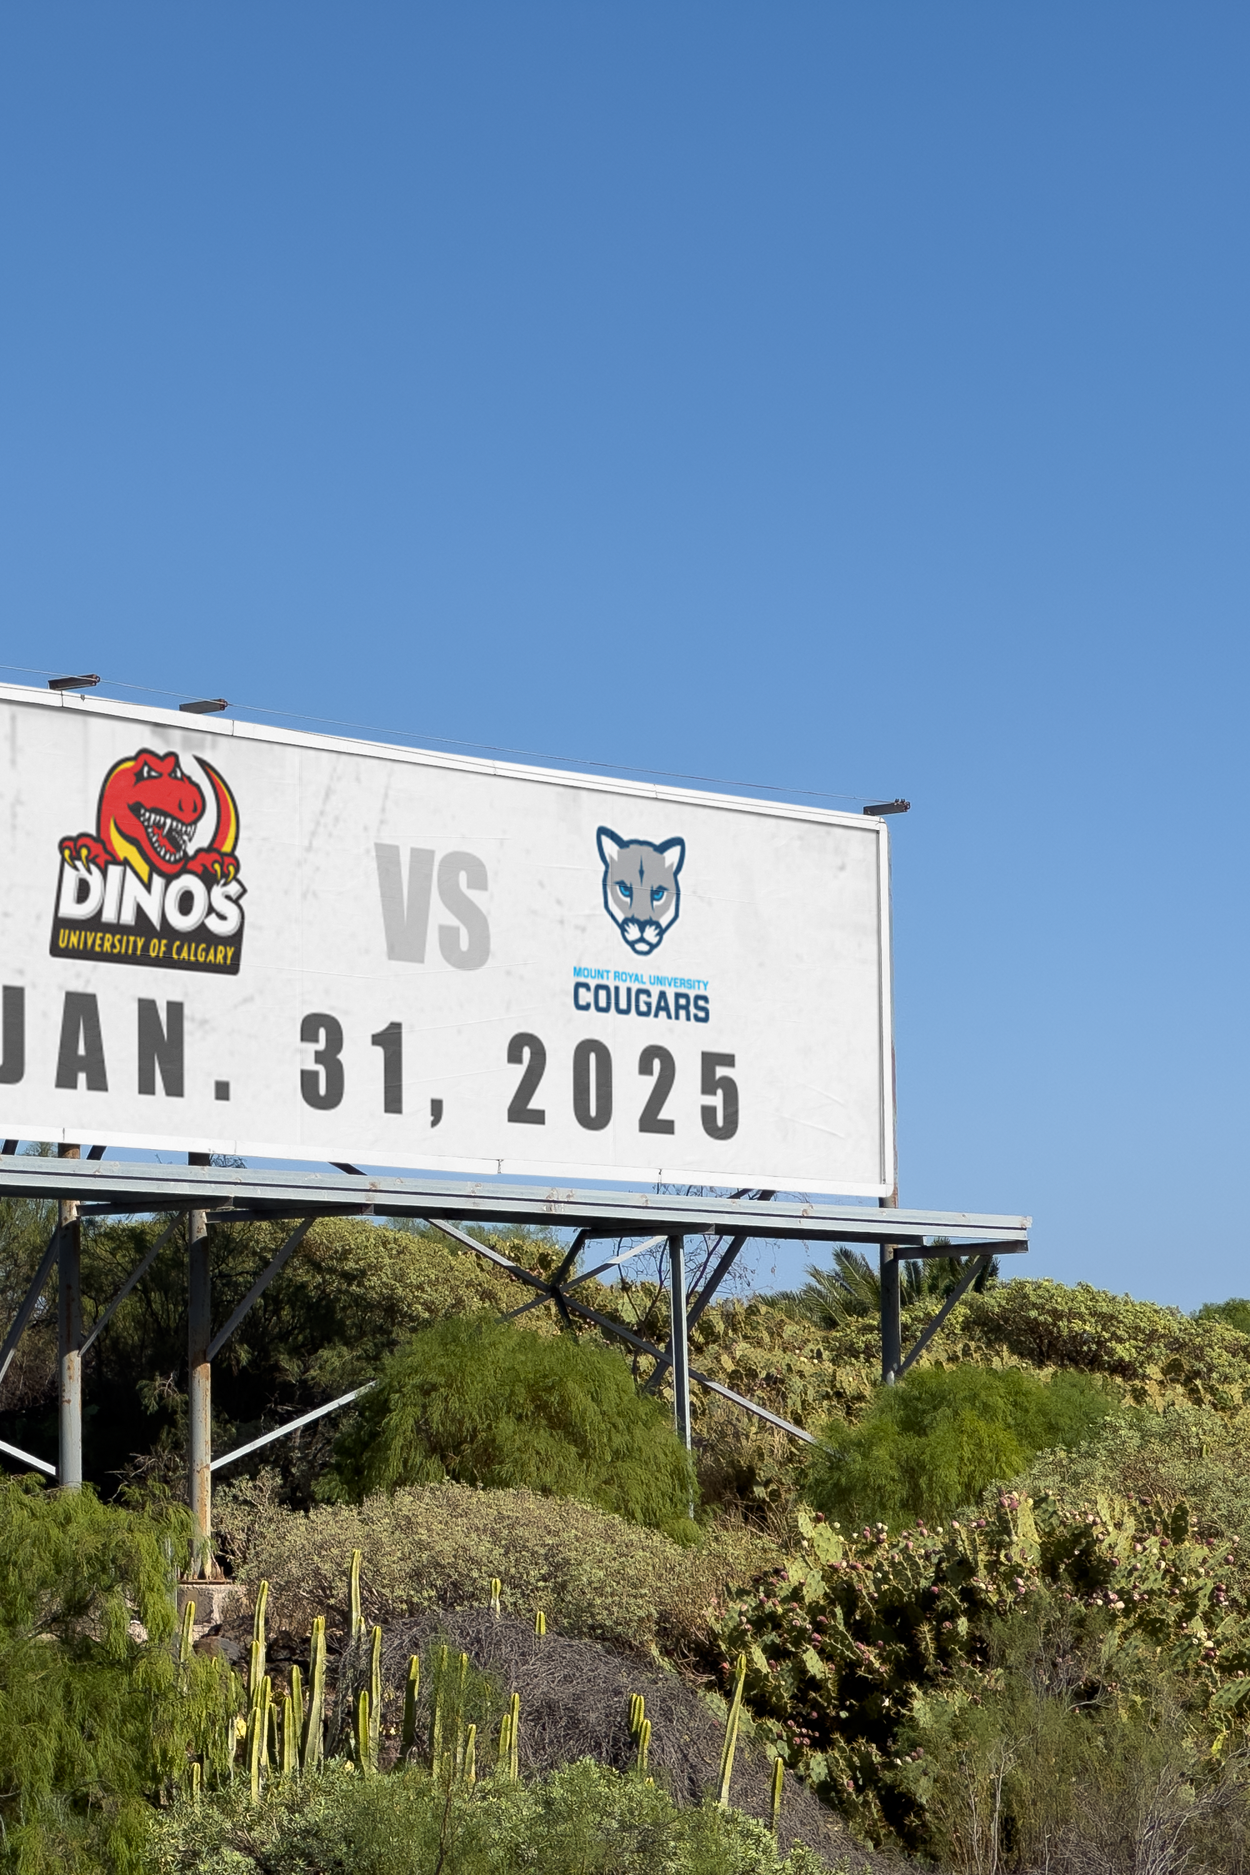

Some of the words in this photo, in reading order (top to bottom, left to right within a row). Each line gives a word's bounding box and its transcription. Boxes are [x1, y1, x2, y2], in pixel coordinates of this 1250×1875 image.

[58, 860, 245, 936] DINOS
[374, 842, 491, 970] VS
[58, 929, 144, 956] UNIVERSITY
[149, 938, 168, 958] OF
[172, 941, 235, 966] CALGARY
[574, 967, 611, 980] MOUNT
[614, 971, 646, 985] ROYAL
[649, 975, 709, 991] UNIVERSITY
[574, 982, 710, 1023] COUGARS
[299, 1012, 444, 1128] 31,
[506, 1031, 740, 1141] 2025
